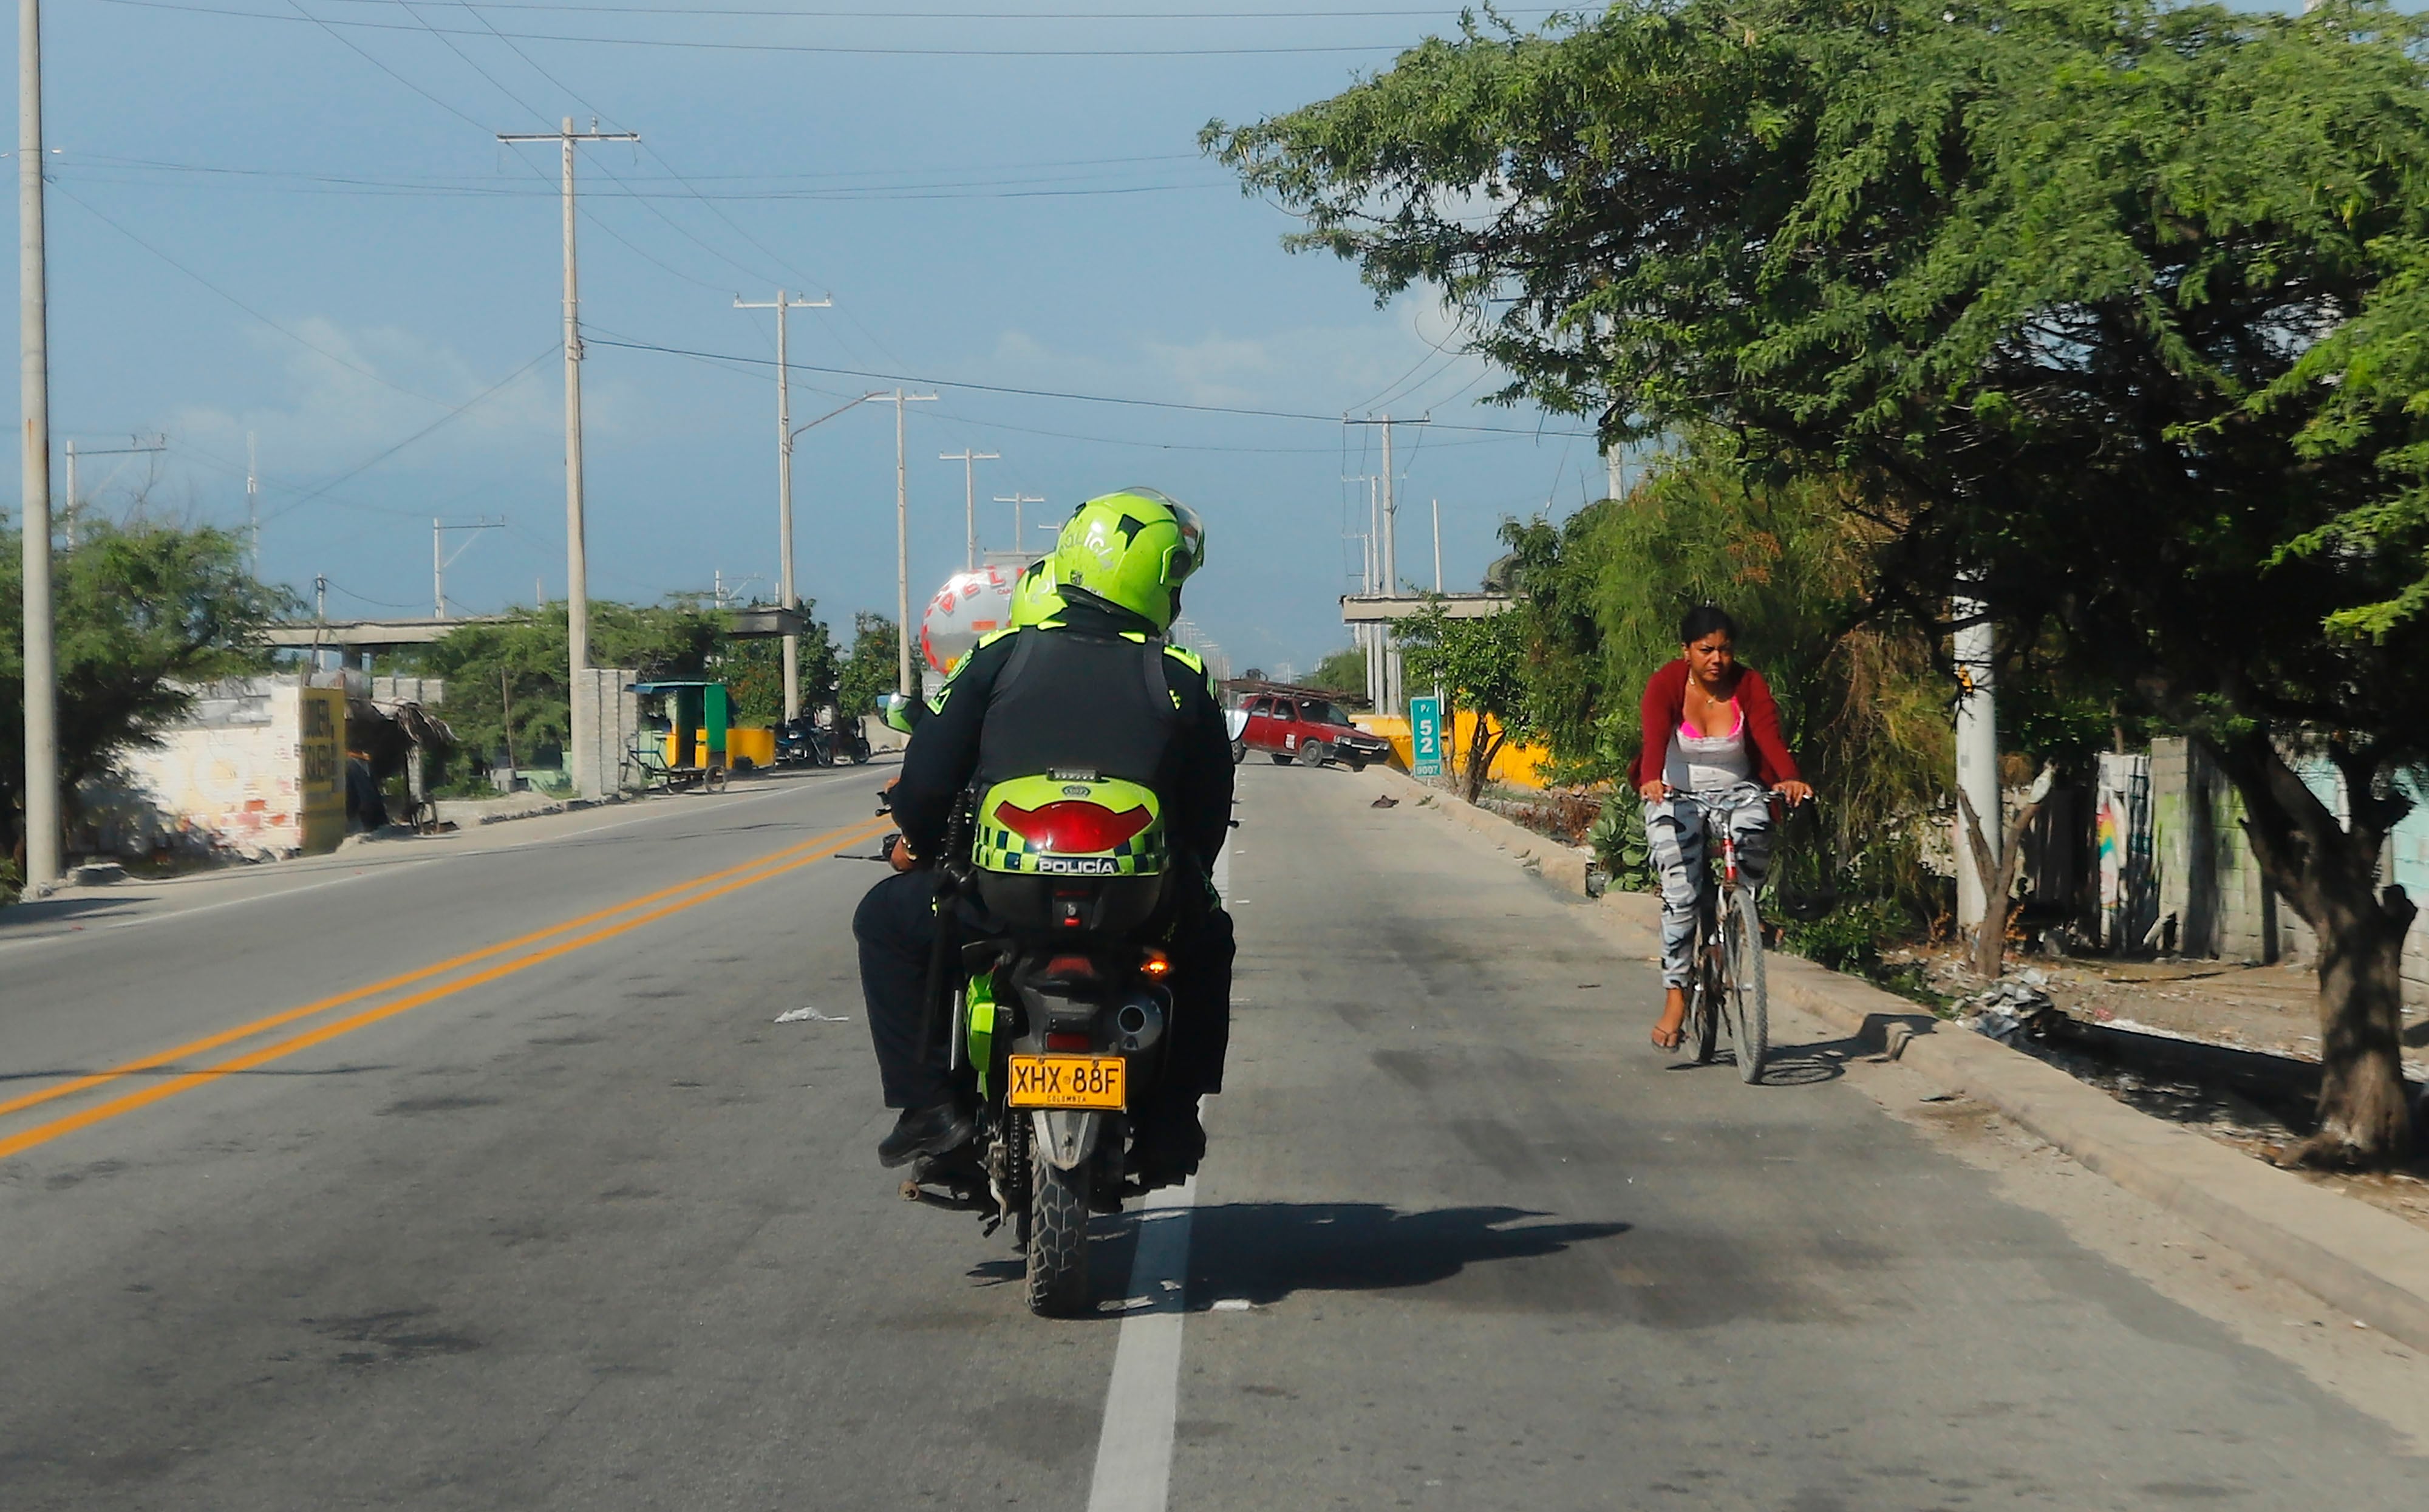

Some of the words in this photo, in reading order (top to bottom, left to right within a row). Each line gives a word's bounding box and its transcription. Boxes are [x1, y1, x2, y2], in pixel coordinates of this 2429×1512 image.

[1038, 858, 1115, 874] POLICÍA
[1015, 1066, 1061, 1094] XHX
[1072, 1067, 1119, 1095] 88F
